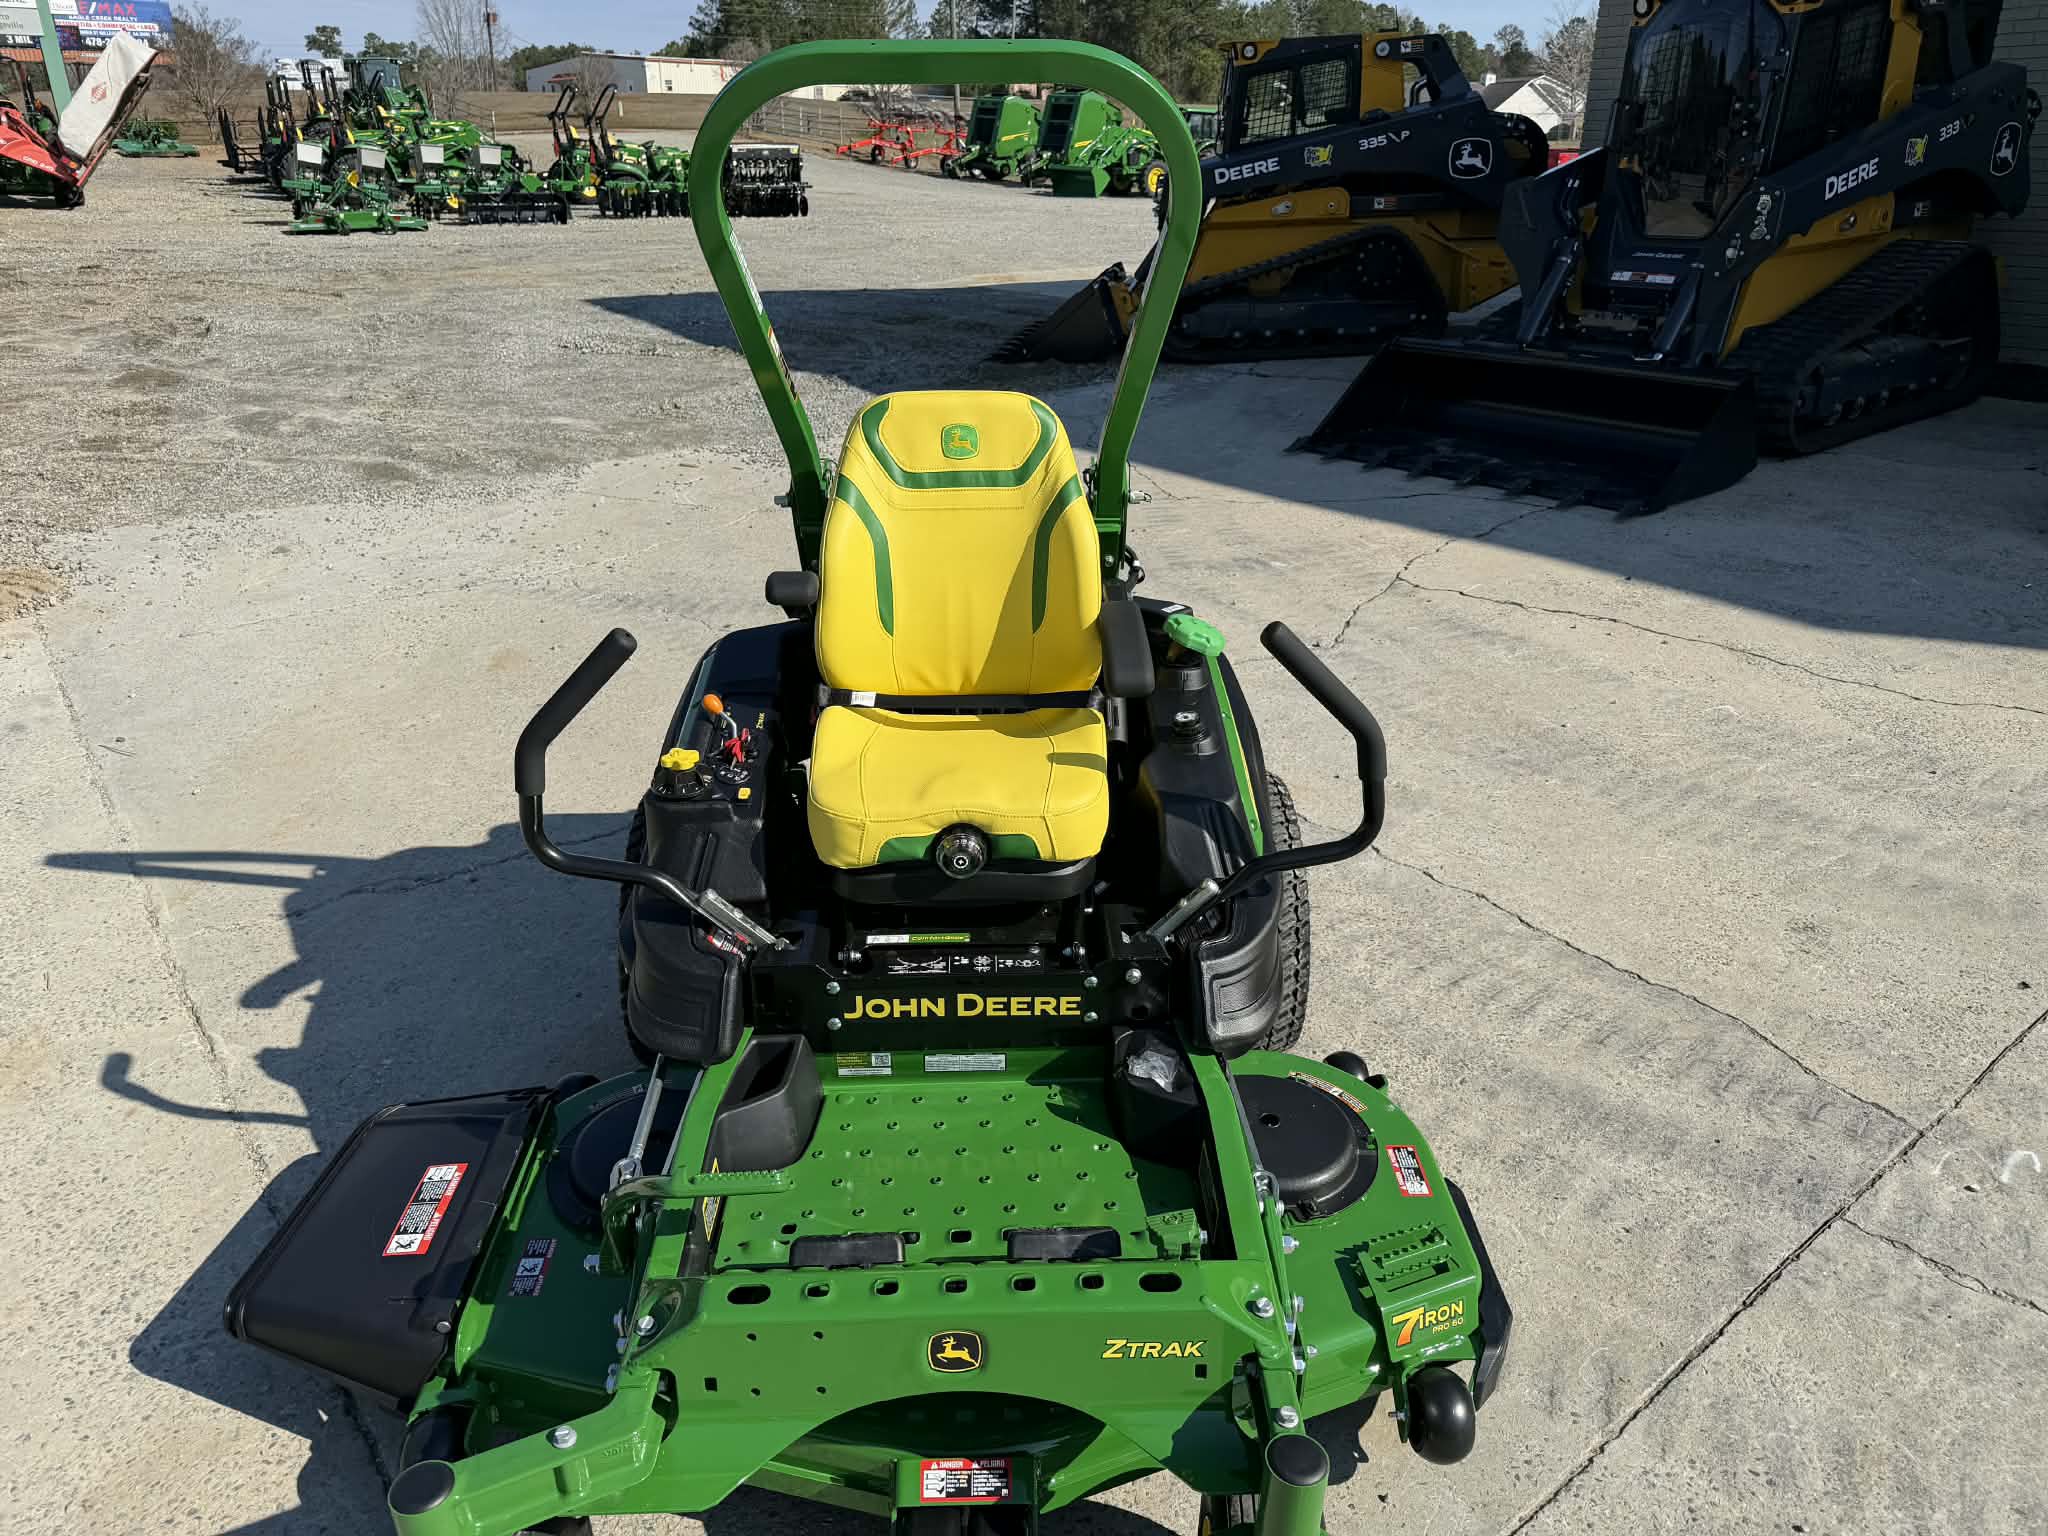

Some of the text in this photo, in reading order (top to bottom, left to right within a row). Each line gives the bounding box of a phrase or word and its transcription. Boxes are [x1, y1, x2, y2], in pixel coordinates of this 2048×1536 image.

[79, 0, 137, 17] E/MAX
[1939, 119, 1961, 142] 333
[1358, 134, 1388, 150] 335
[1214, 157, 1281, 185] DEERE
[1824, 157, 1880, 201] DEERE
[843, 993, 1082, 1019] JOHN DEERE
[1432, 1322, 1450, 1335] PRO
[1101, 1338, 1207, 1359] ZTRAK
[939, 1460, 964, 1469] DANGER
